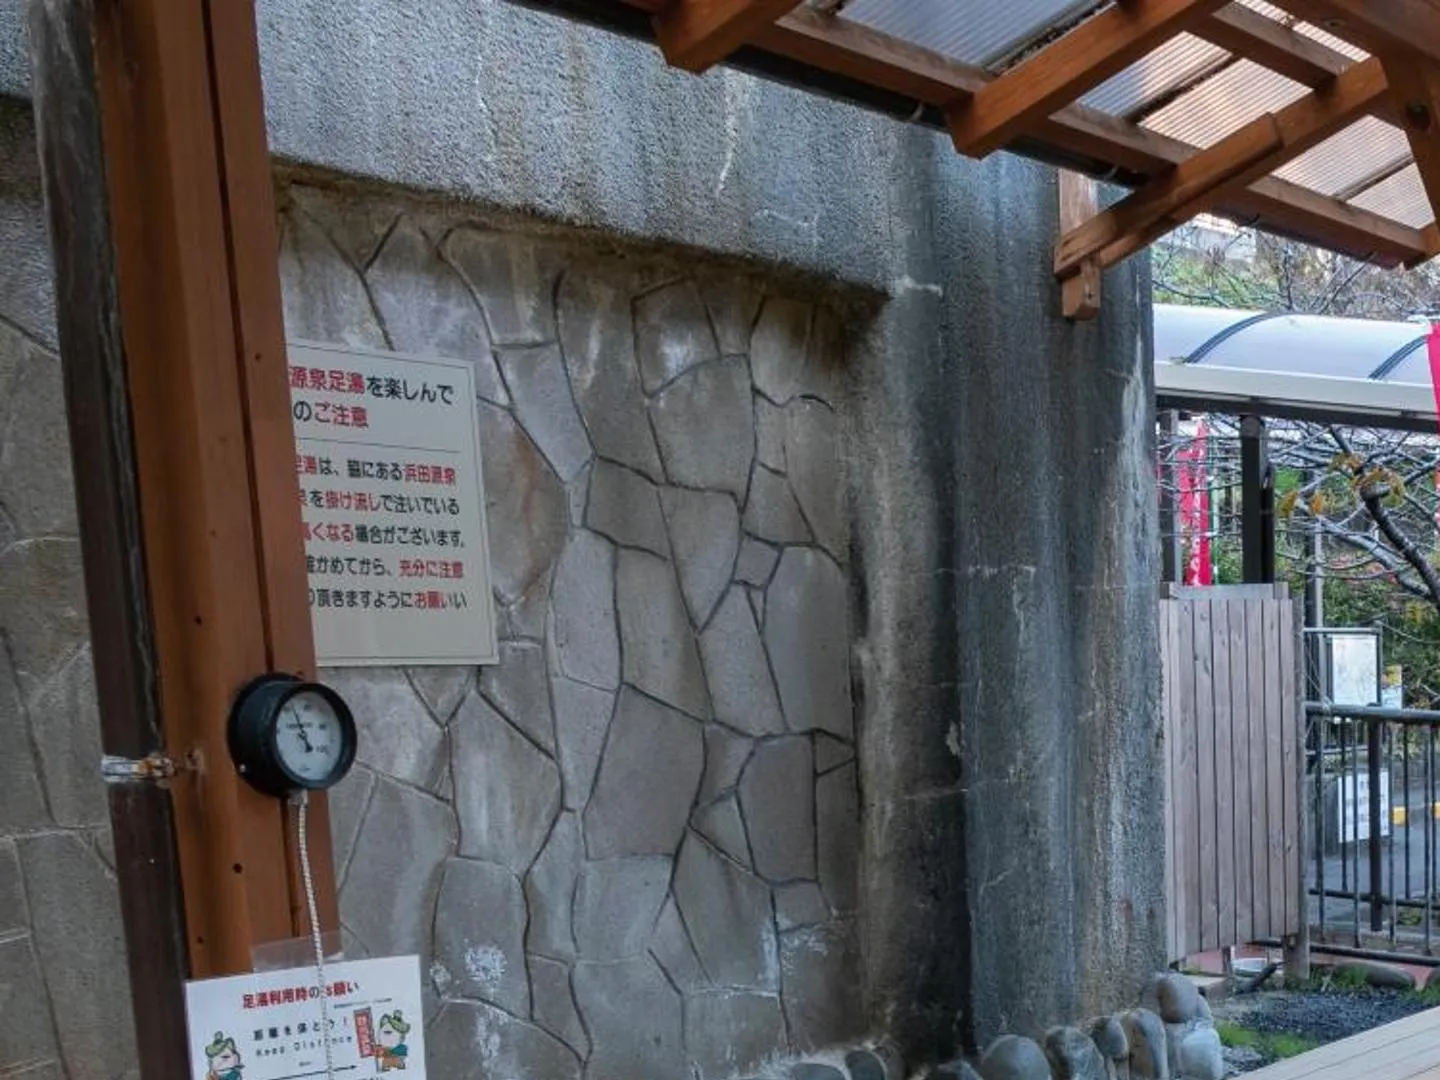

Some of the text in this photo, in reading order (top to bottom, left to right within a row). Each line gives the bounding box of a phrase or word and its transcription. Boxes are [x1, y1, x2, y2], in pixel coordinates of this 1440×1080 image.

[289, 365, 454, 405] 源泉足湯を楽しんで
[293, 400, 369, 429] のご注意
